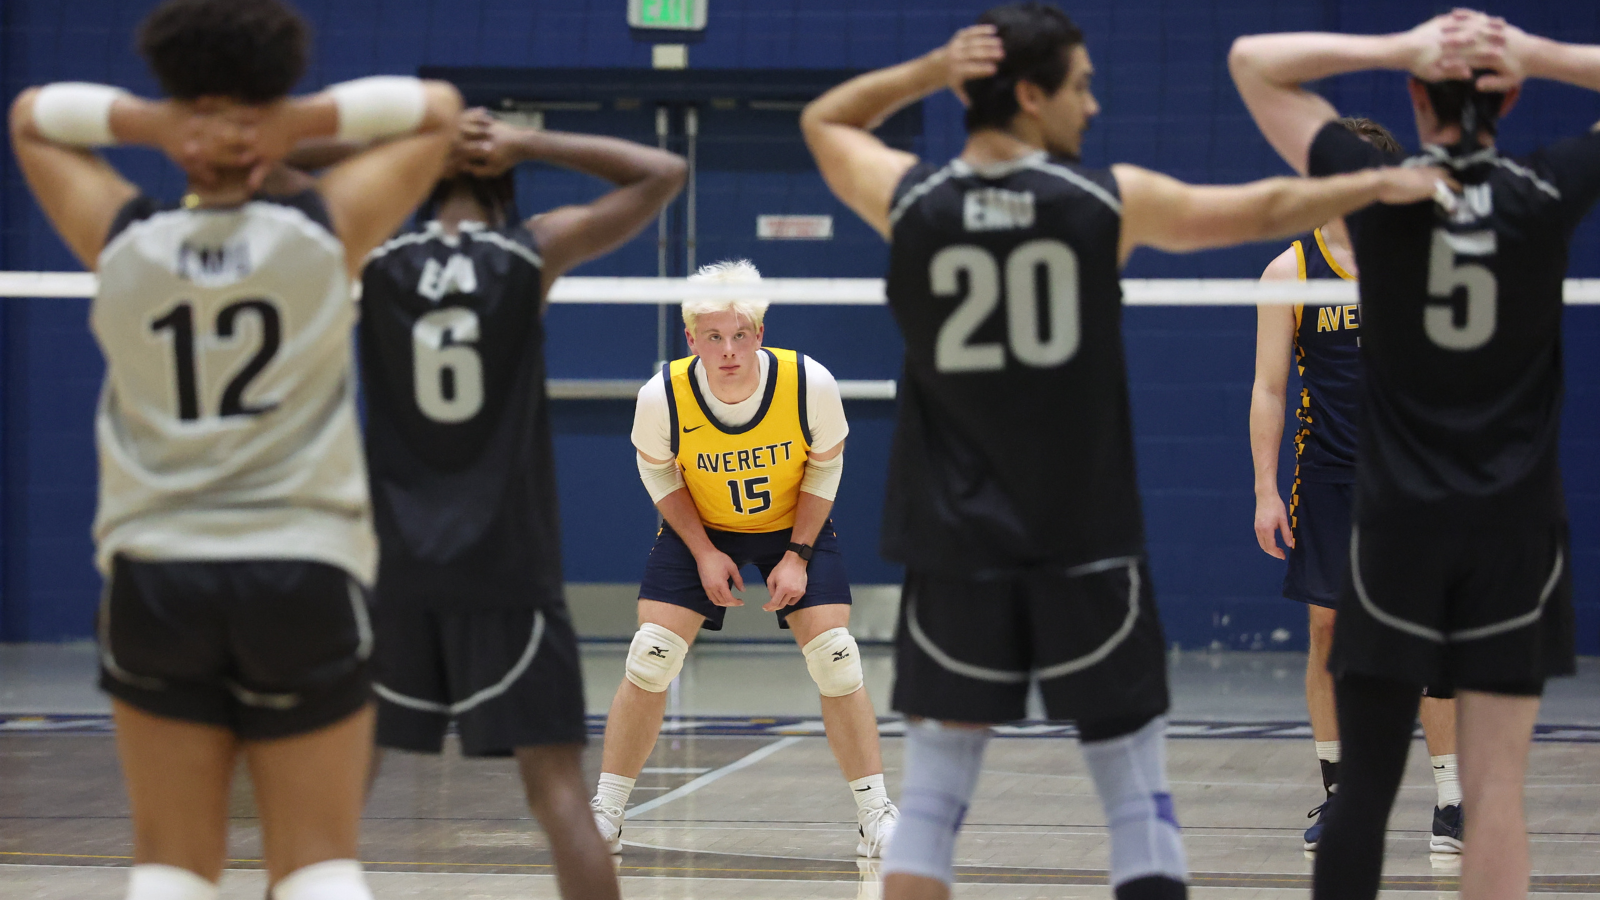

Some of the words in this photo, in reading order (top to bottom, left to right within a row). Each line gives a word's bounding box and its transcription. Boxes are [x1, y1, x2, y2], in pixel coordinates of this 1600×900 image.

[929, 240, 1080, 372] 20
[1317, 304, 1362, 333] AVE
[1424, 228, 1497, 350] 5
[150, 301, 281, 421] 12
[413, 306, 483, 423] 6
[696, 441, 793, 473] AVERETT
[726, 475, 771, 515] 15
